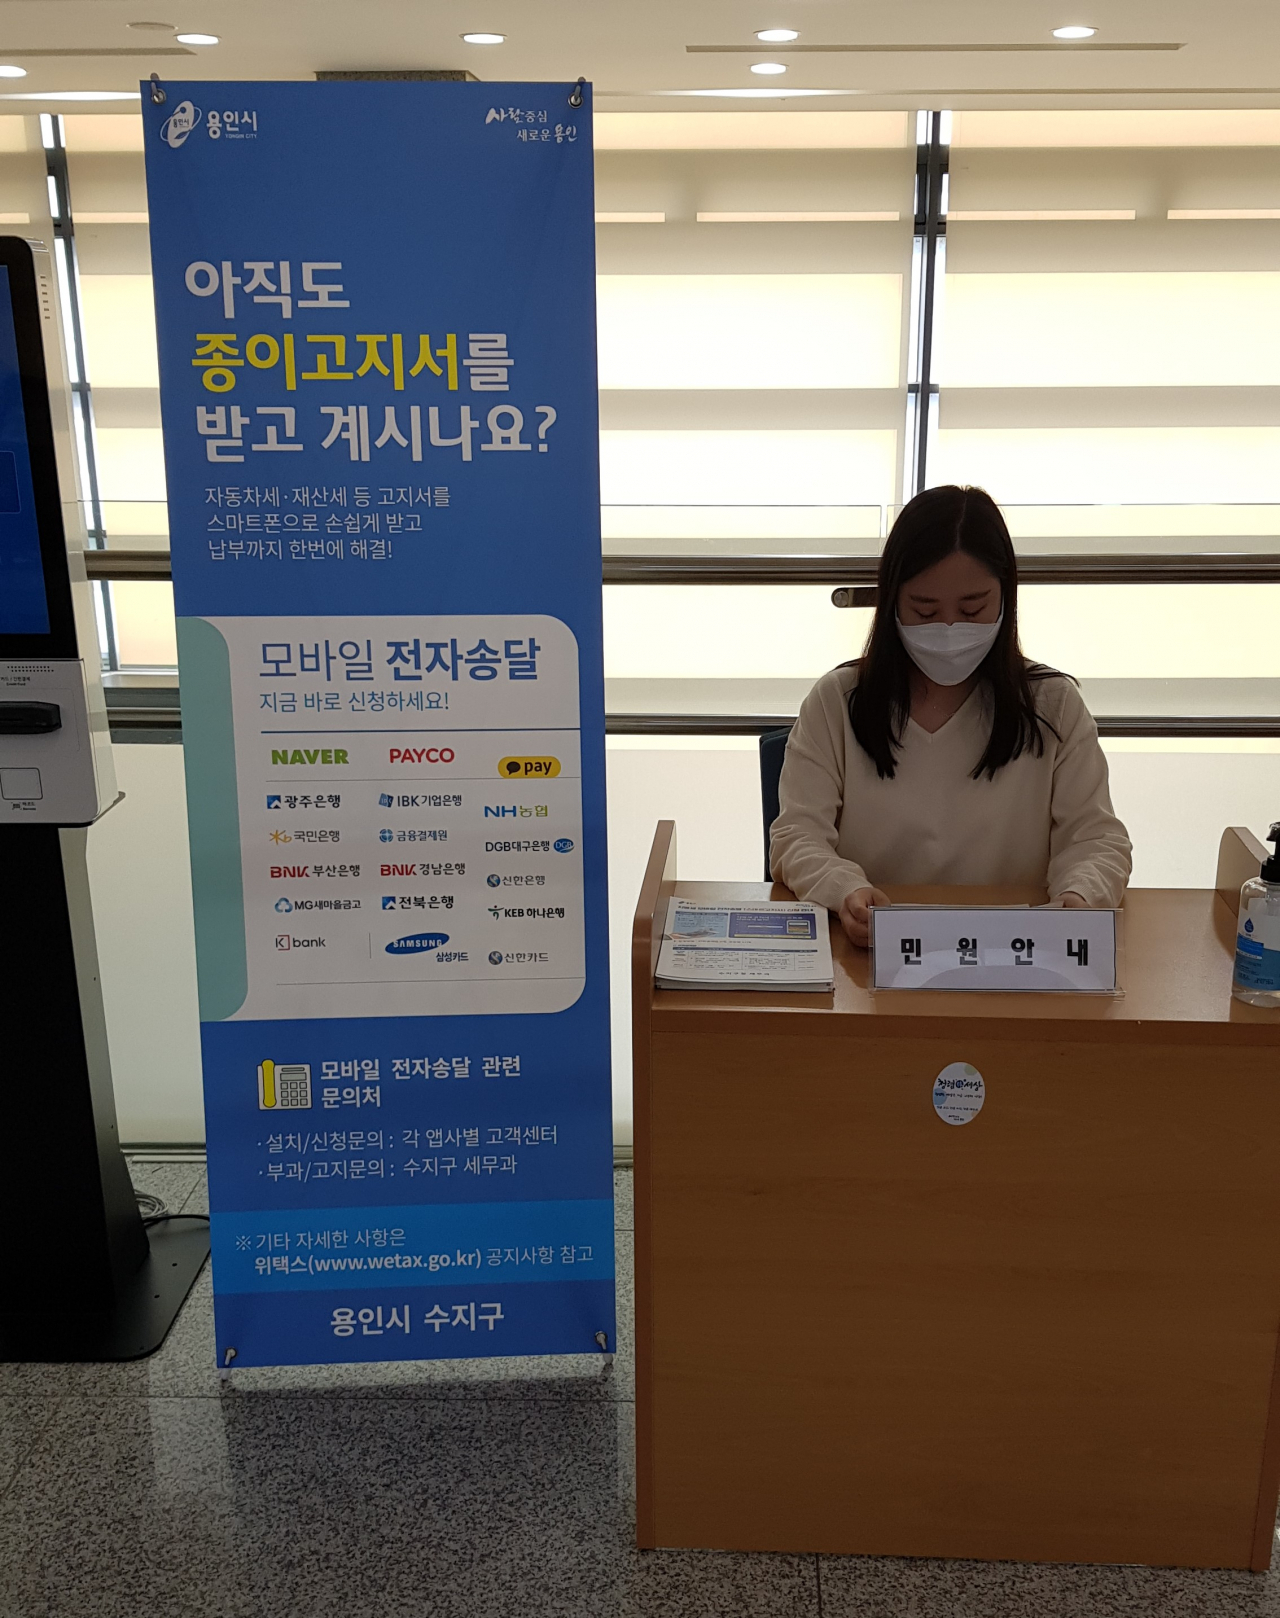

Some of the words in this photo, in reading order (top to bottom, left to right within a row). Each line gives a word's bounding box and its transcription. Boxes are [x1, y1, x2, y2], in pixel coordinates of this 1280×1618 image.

[205, 108, 258, 139] 용인시
[517, 129, 551, 141] 새로운
[555, 124, 576, 143] 용인
[185, 261, 350, 318] 아직도
[191, 333, 514, 393] 종이고지서를
[197, 406, 303, 462] 받고
[320, 405, 556, 461] 계시나요?
[205, 487, 346, 507] 자동차세·재산세
[354, 487, 371, 507] 등
[378, 487, 450, 507] 고지서를
[208, 513, 319, 533] 스마트폰으로
[325, 513, 379, 533] 손쉽게
[386, 513, 422, 533] 받고
[209, 540, 282, 559] 납부까지
[289, 539, 343, 559] 한번에
[350, 539, 391, 559] 해결!
[260, 640, 374, 681] 모바일
[386, 638, 541, 681] 전자송달
[260, 692, 297, 712] 지금
[304, 692, 342, 712] 바로
[349, 691, 448, 711] 신청하세요!
[272, 749, 349, 765] NAVER
[390, 748, 454, 763] PAYCO
[524, 762, 552, 775] pay
[285, 795, 340, 809] 광주은행
[484, 806, 547, 817] NH농협
[294, 830, 339, 842] 국민은행
[397, 830, 447, 841] 금융결제원
[486, 841, 549, 852] DGB대구은행
[270, 866, 310, 878] BNK
[312, 865, 360, 877] 부산은행
[381, 864, 417, 876] BNK
[420, 863, 465, 875] 경남은행
[502, 876, 545, 886] 신한은행
[294, 900, 361, 910] MG새마을금고
[399, 896, 453, 909] 전북은행
[504, 908, 524, 917] KEB
[527, 908, 564, 918] 하나은행
[293, 937, 325, 947] bank
[393, 939, 442, 947] SAMSUNG
[436, 952, 469, 962] 삼성카드
[504, 953, 548, 963] 신한카드
[321, 1059, 379, 1081] 모바일
[392, 1057, 471, 1079] 전자송달
[482, 1056, 520, 1077] 관련
[322, 1086, 380, 1108] 문의처
[403, 1129, 420, 1148] 각
[426, 1127, 479, 1147] 앱사별
[486, 1125, 556, 1145] 고객센터
[404, 1157, 457, 1177] 수지구
[464, 1155, 517, 1174] 세무과
[257, 1232, 290, 1251] 기타
[297, 1230, 348, 1249] 자세한
[355, 1229, 405, 1247] 사항은
[255, 1249, 481, 1275] 위택스(www.wetax.go.kr)
[487, 1246, 554, 1266] 공지사항
[560, 1245, 593, 1263] 참고
[331, 1305, 409, 1336] 용인시
[424, 1303, 504, 1332] 수지구
